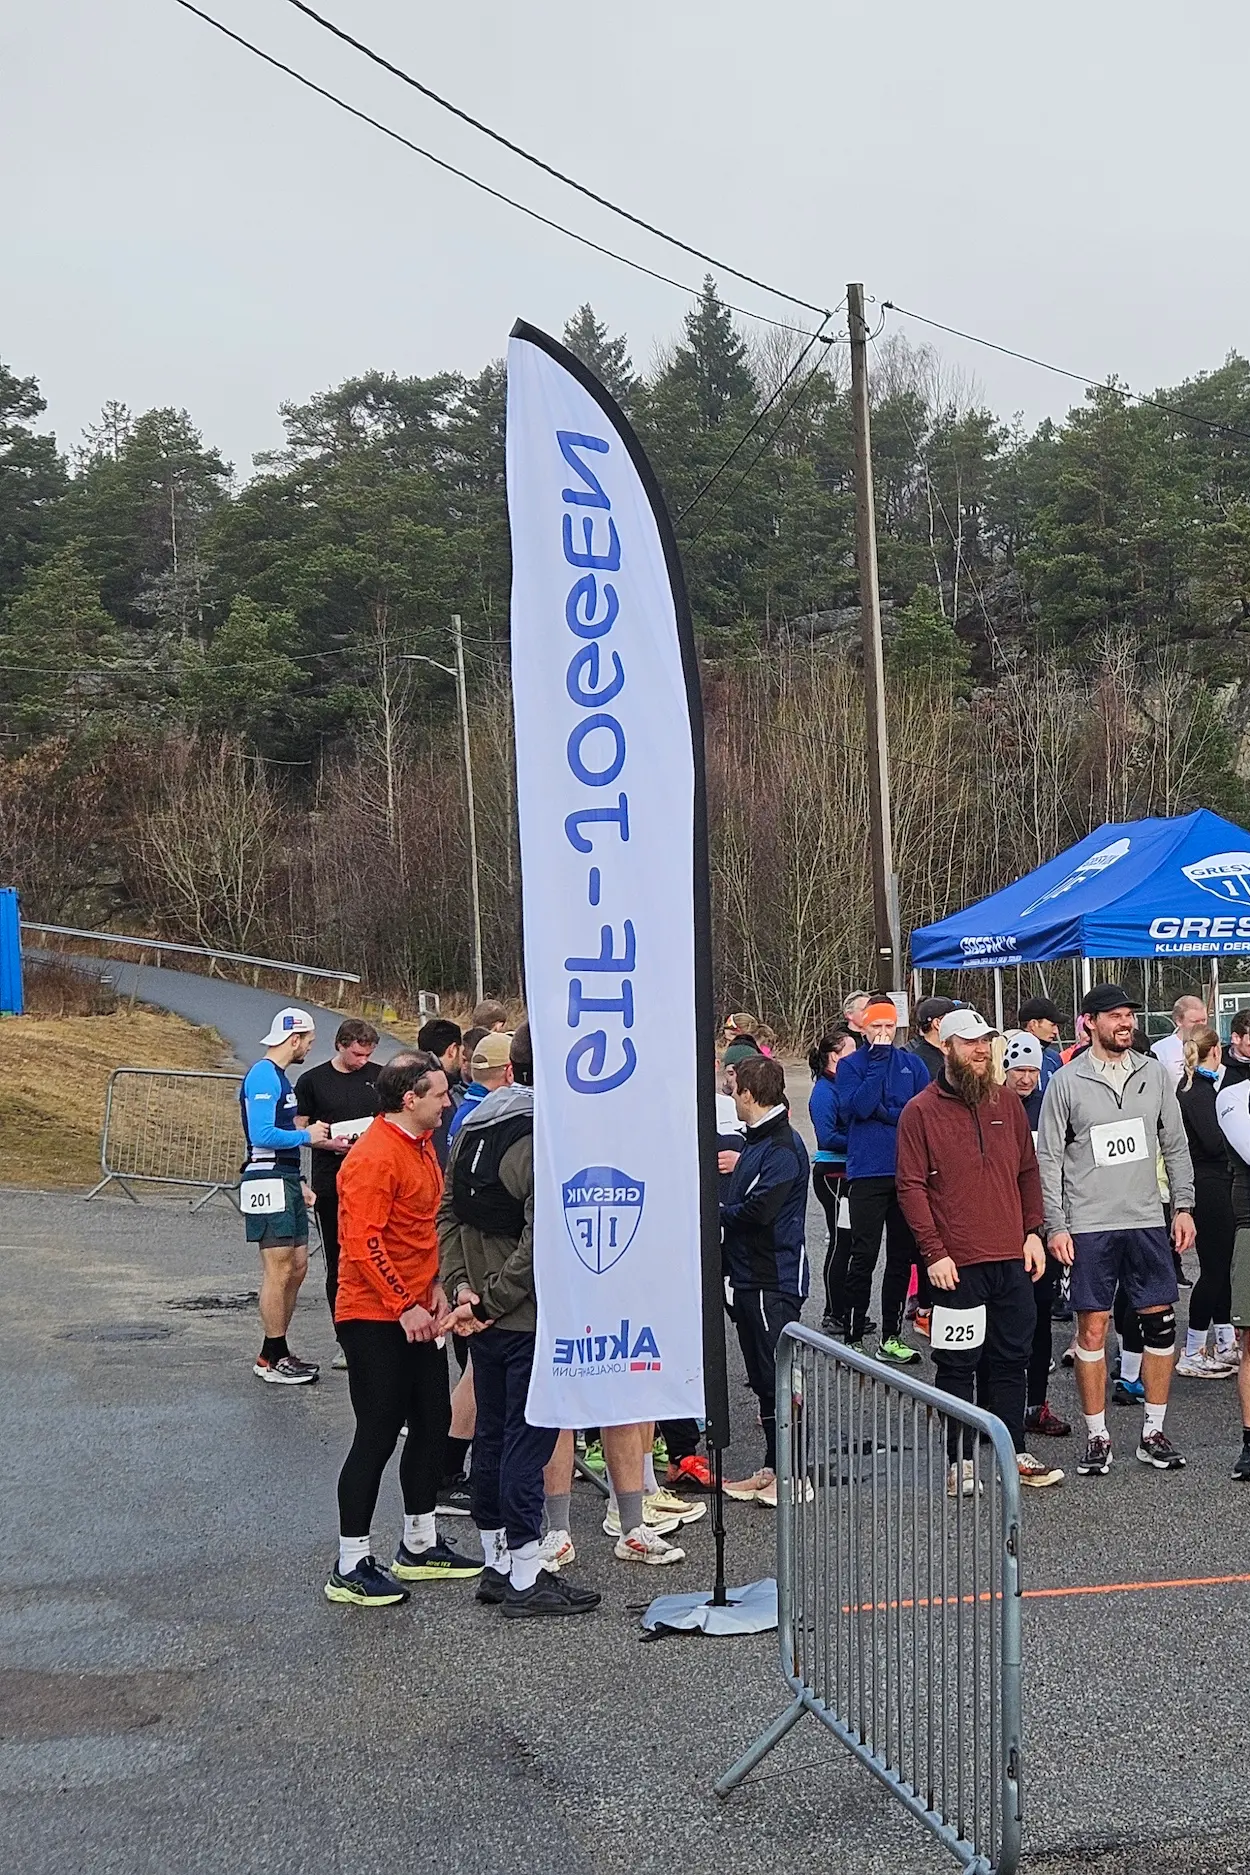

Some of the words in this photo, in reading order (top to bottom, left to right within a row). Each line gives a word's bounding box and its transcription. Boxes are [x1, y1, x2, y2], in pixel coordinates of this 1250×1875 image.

[1155, 942, 1220, 953] KLUBBEN
[1223, 941, 1250, 951] DER
[1106, 1136, 1135, 1158] 200
[250, 1192, 271, 1208] 201
[944, 1324, 975, 1342] 225
